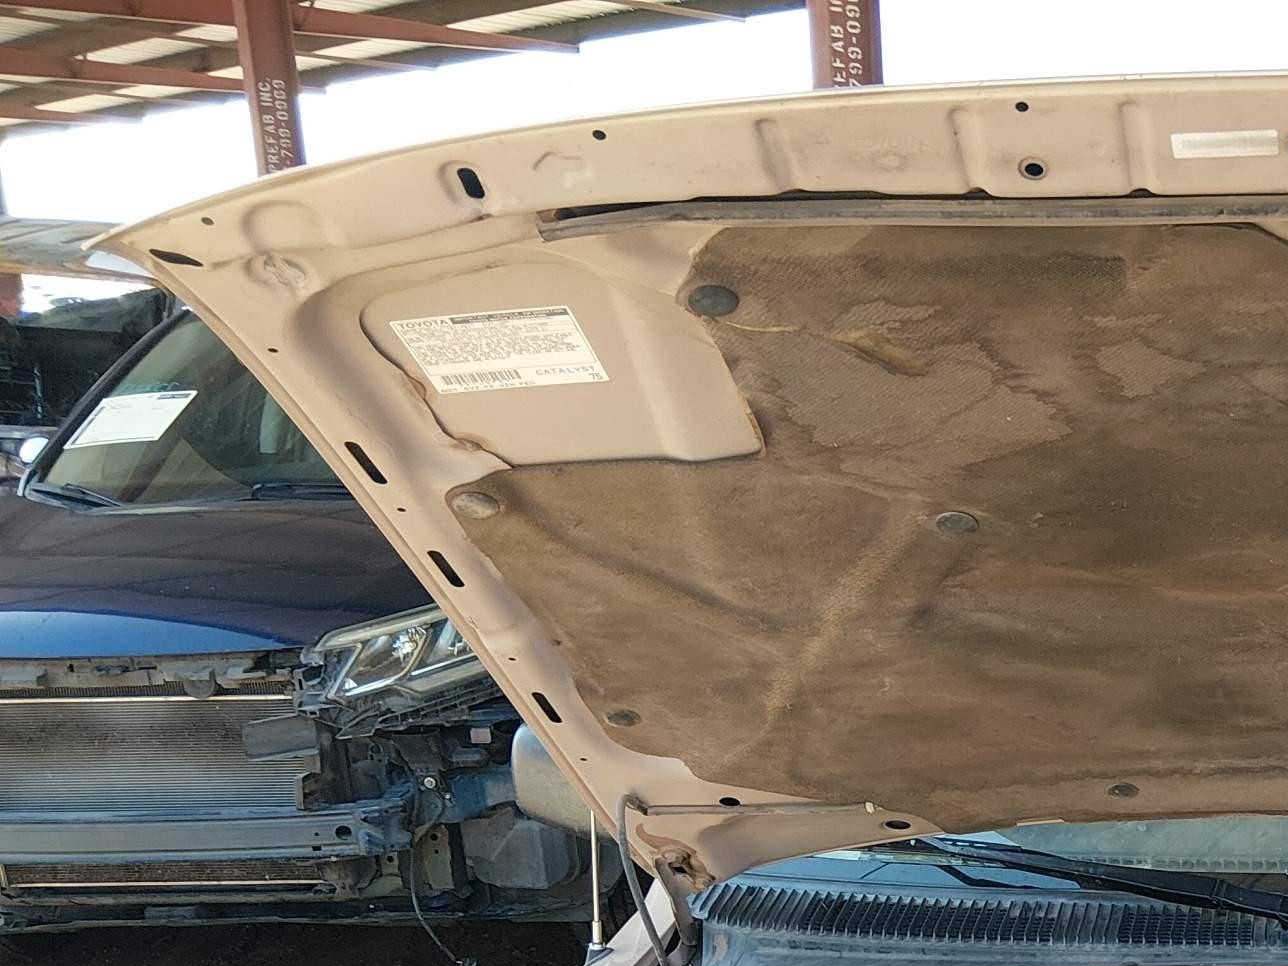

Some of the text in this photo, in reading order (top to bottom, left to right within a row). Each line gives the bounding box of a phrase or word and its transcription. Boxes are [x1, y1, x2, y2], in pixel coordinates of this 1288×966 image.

[845, 0, 863, 88] 799-09
[262, 113, 280, 173] PREFAB
[399, 319, 449, 330] TOYOTA
[536, 365, 596, 376] CATALYST
